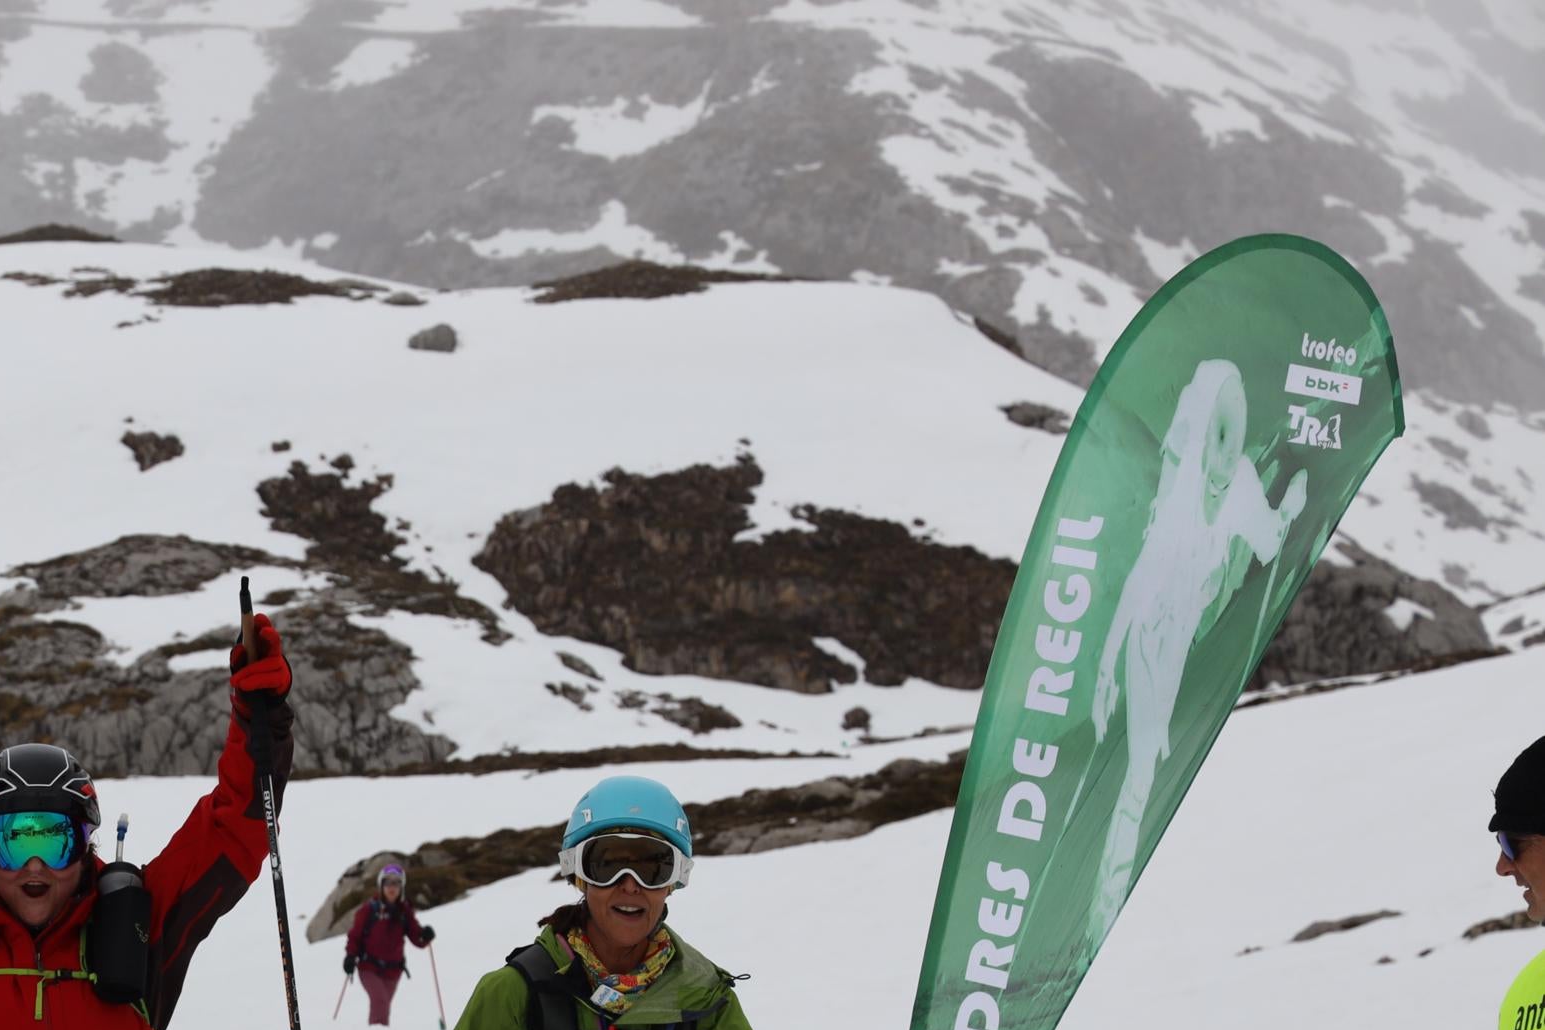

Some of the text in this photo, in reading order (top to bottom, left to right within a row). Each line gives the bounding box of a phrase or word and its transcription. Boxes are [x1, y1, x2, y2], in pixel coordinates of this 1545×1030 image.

[1302, 332, 1357, 366] trofeo
[1305, 375, 1341, 394] bbk
[1024, 515, 1105, 716] REGIL
[997, 737, 1059, 841] DE
